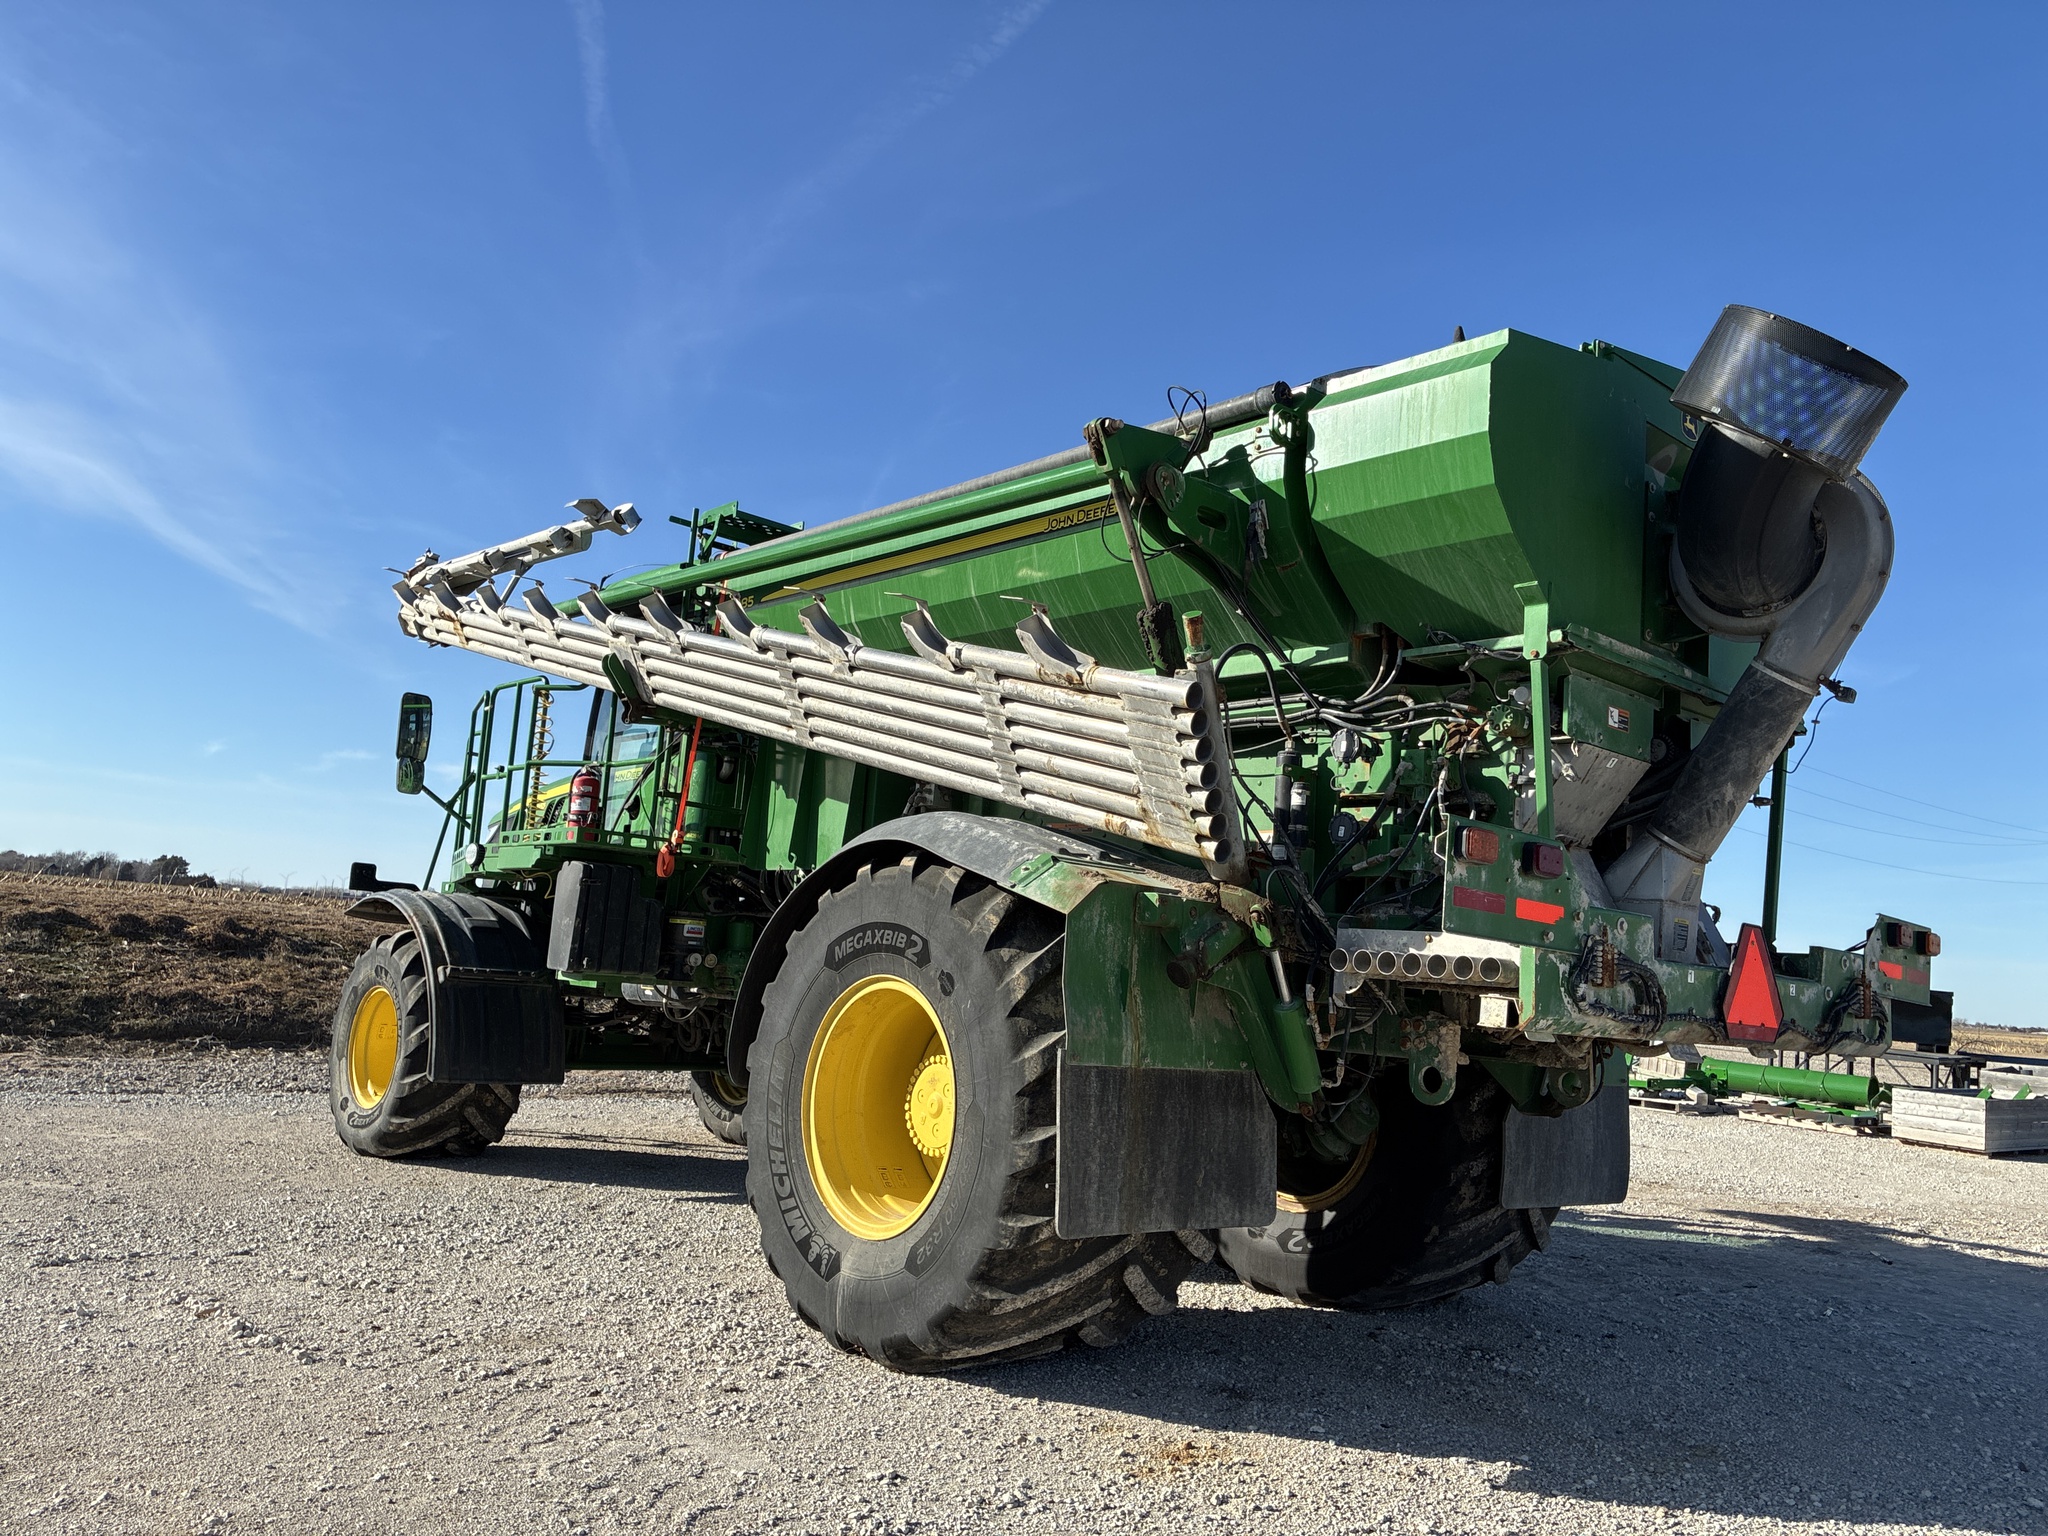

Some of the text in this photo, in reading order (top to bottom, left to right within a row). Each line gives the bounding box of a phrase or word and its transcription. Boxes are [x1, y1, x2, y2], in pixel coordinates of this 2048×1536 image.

[1044, 513, 1074, 532] JOHN
[741, 595, 755, 609] 85
[834, 929, 923, 963] MEGAXBIB 2
[768, 1059, 810, 1243] MICHELIN
